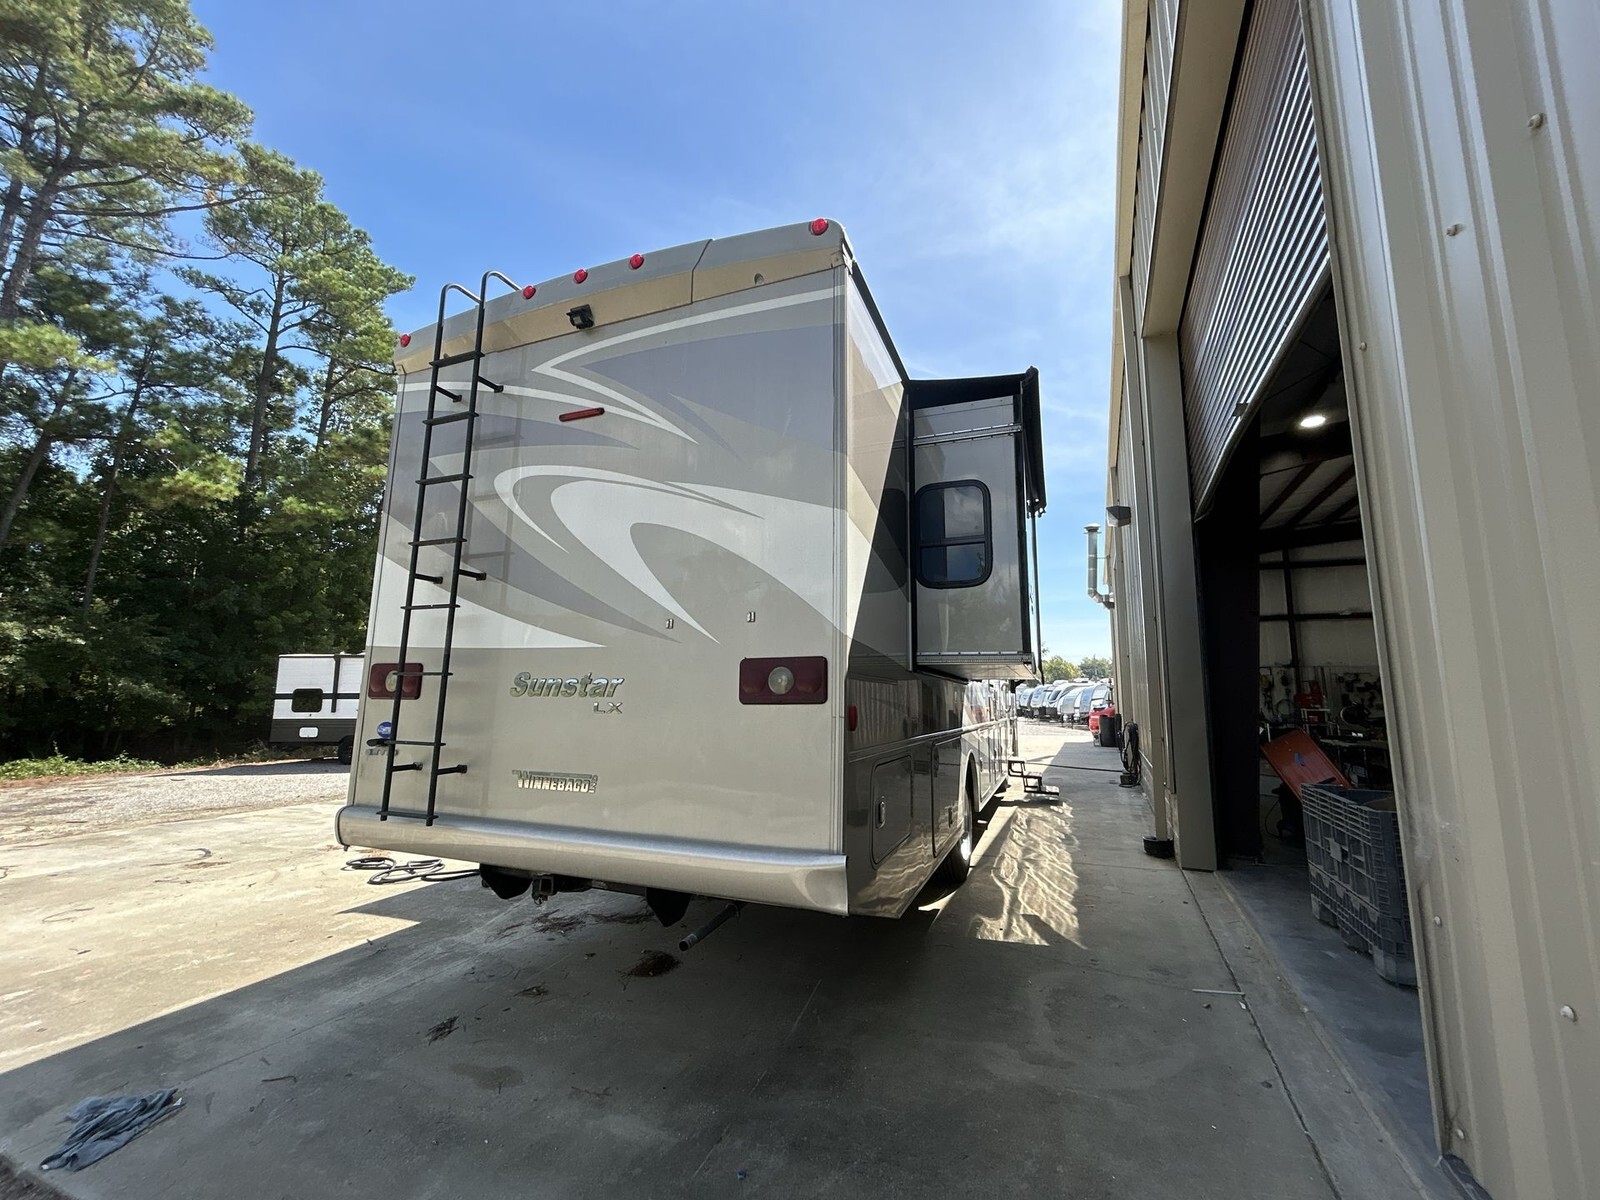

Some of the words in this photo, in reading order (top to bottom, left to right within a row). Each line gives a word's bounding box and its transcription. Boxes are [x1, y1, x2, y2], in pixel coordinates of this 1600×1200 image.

[510, 671, 625, 698] Sunstar
[593, 702, 623, 714] LX
[512, 769, 591, 793] WINNEBAGO
